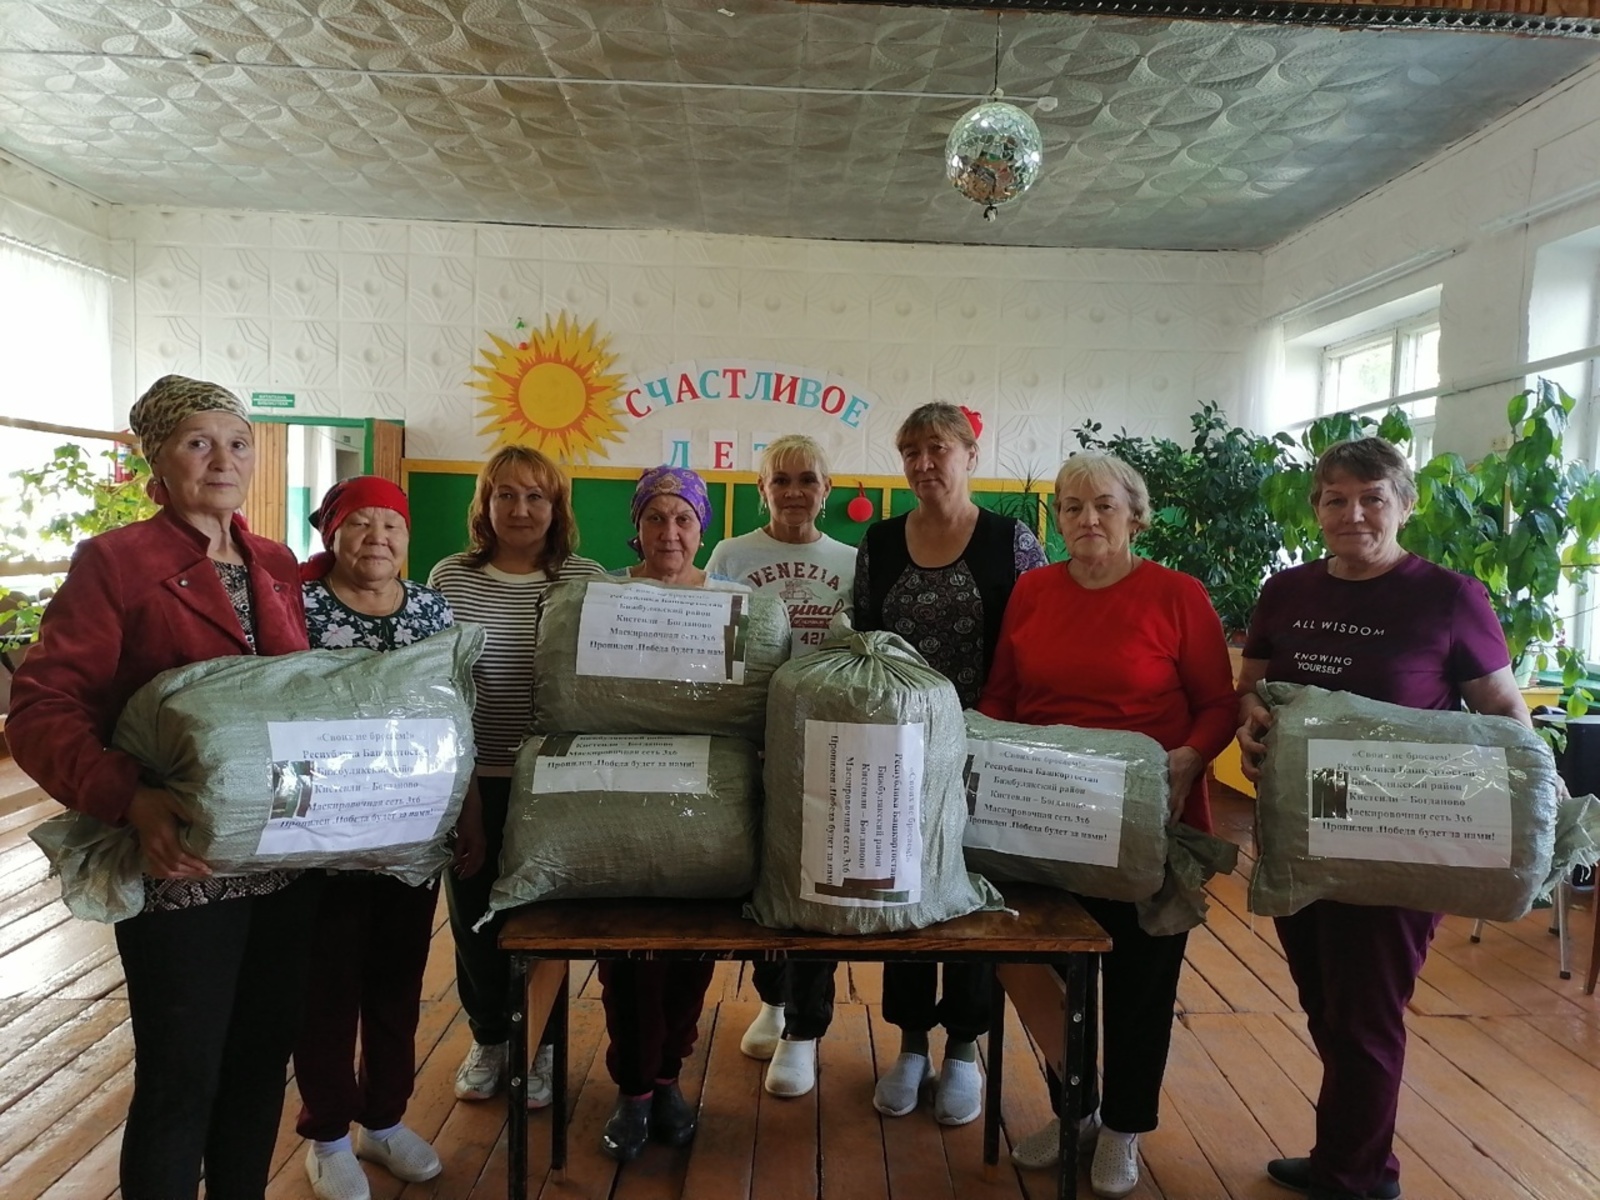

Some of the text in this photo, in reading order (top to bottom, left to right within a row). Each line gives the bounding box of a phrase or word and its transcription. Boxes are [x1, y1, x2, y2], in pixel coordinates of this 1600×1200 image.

[625, 369, 869, 428] СЧАСТЛИВОЕ
[747, 562, 840, 591] VENEZIA
[686, 609, 711, 617] район
[609, 627, 679, 640] Маскировочная
[1292, 620, 1385, 636] ALL WISDOM
[589, 640, 633, 652] Пропилен
[671, 645, 694, 656] будет
[1293, 652, 1352, 665] KNOWING
[1297, 661, 1343, 674] YOURSELF
[547, 760, 592, 770] Пропилен
[631, 760, 656, 769] будет
[829, 735, 839, 783] Пропилен
[892, 753, 903, 809] Республика
[984, 761, 1099, 784] Республика Башкортостан
[842, 756, 854, 833] Маскировочная
[993, 776, 1086, 795] Бижбулякский район
[1430, 781, 1462, 793] район
[1410, 795, 1466, 807] Богданово
[874, 766, 887, 867] Бижбулякский район
[984, 803, 1052, 819] Маскировочная
[1054, 813, 1073, 822] сеть
[1429, 812, 1451, 822] сеть
[826, 824, 836, 849] будет
[1044, 825, 1067, 838] будет
[1070, 830, 1079, 838] за
[1080, 830, 1107, 842] нами!
[1322, 821, 1373, 834] Пропилен
[1418, 826, 1447, 839] будет
[1463, 830, 1495, 842] нами!
[843, 835, 851, 854] сеть
[858, 819, 869, 869] Богданово
